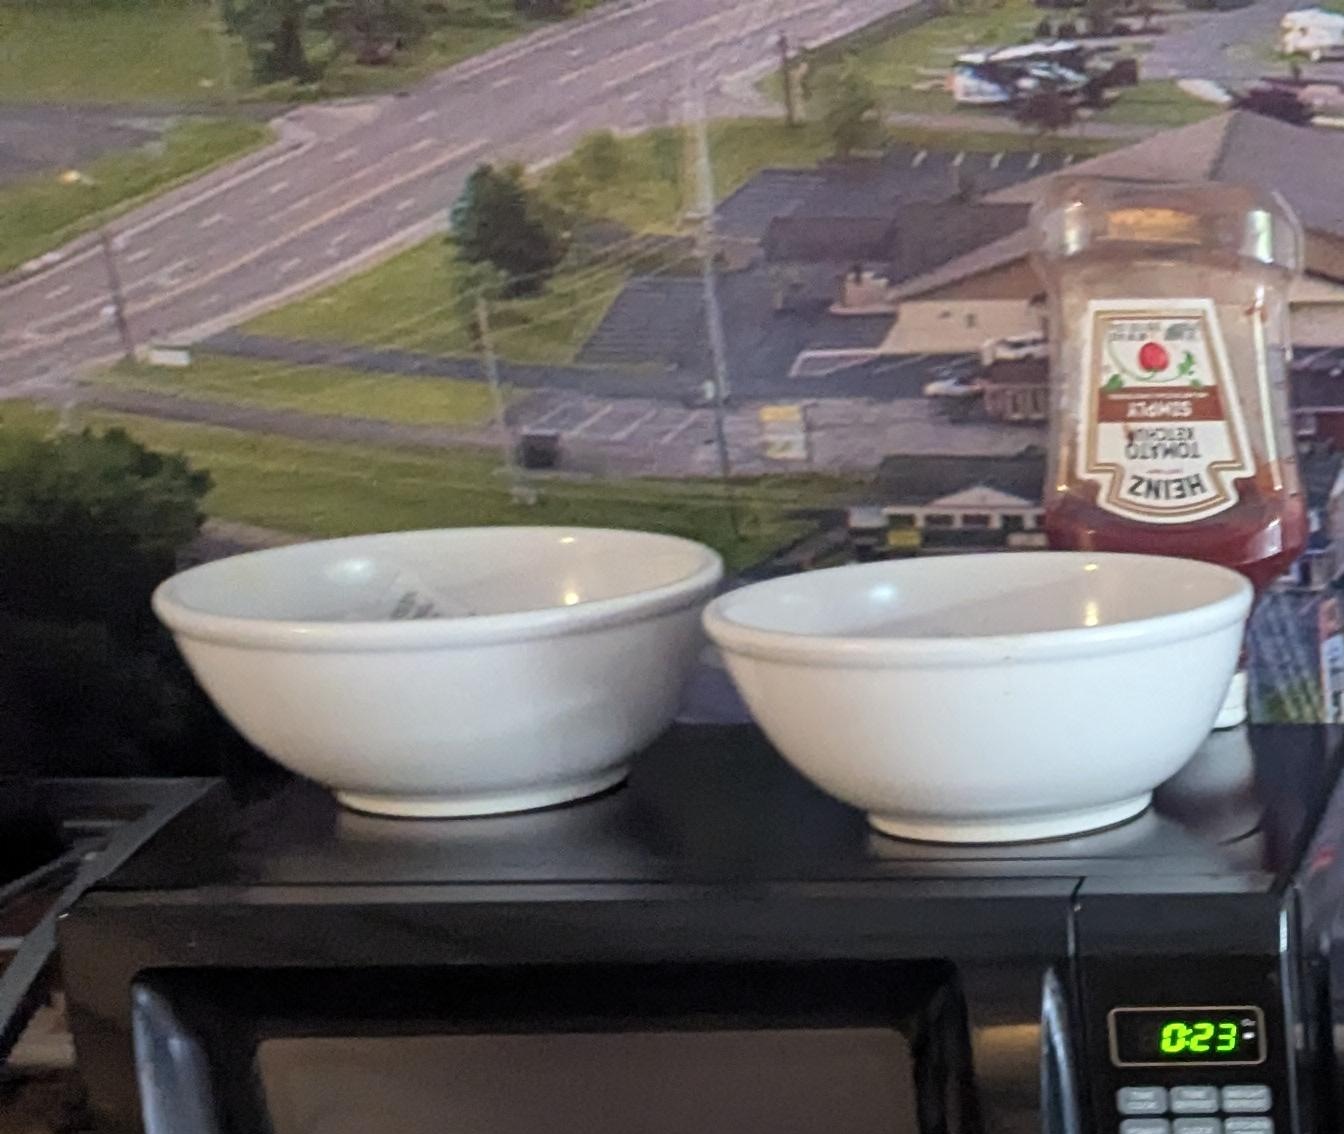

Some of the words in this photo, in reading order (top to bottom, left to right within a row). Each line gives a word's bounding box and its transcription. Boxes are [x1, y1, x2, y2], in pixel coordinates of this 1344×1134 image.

[1124, 441, 1202, 460] TOMATO
[1127, 474, 1207, 500] HEINZ
[1161, 1022, 1237, 1053] 0:23
